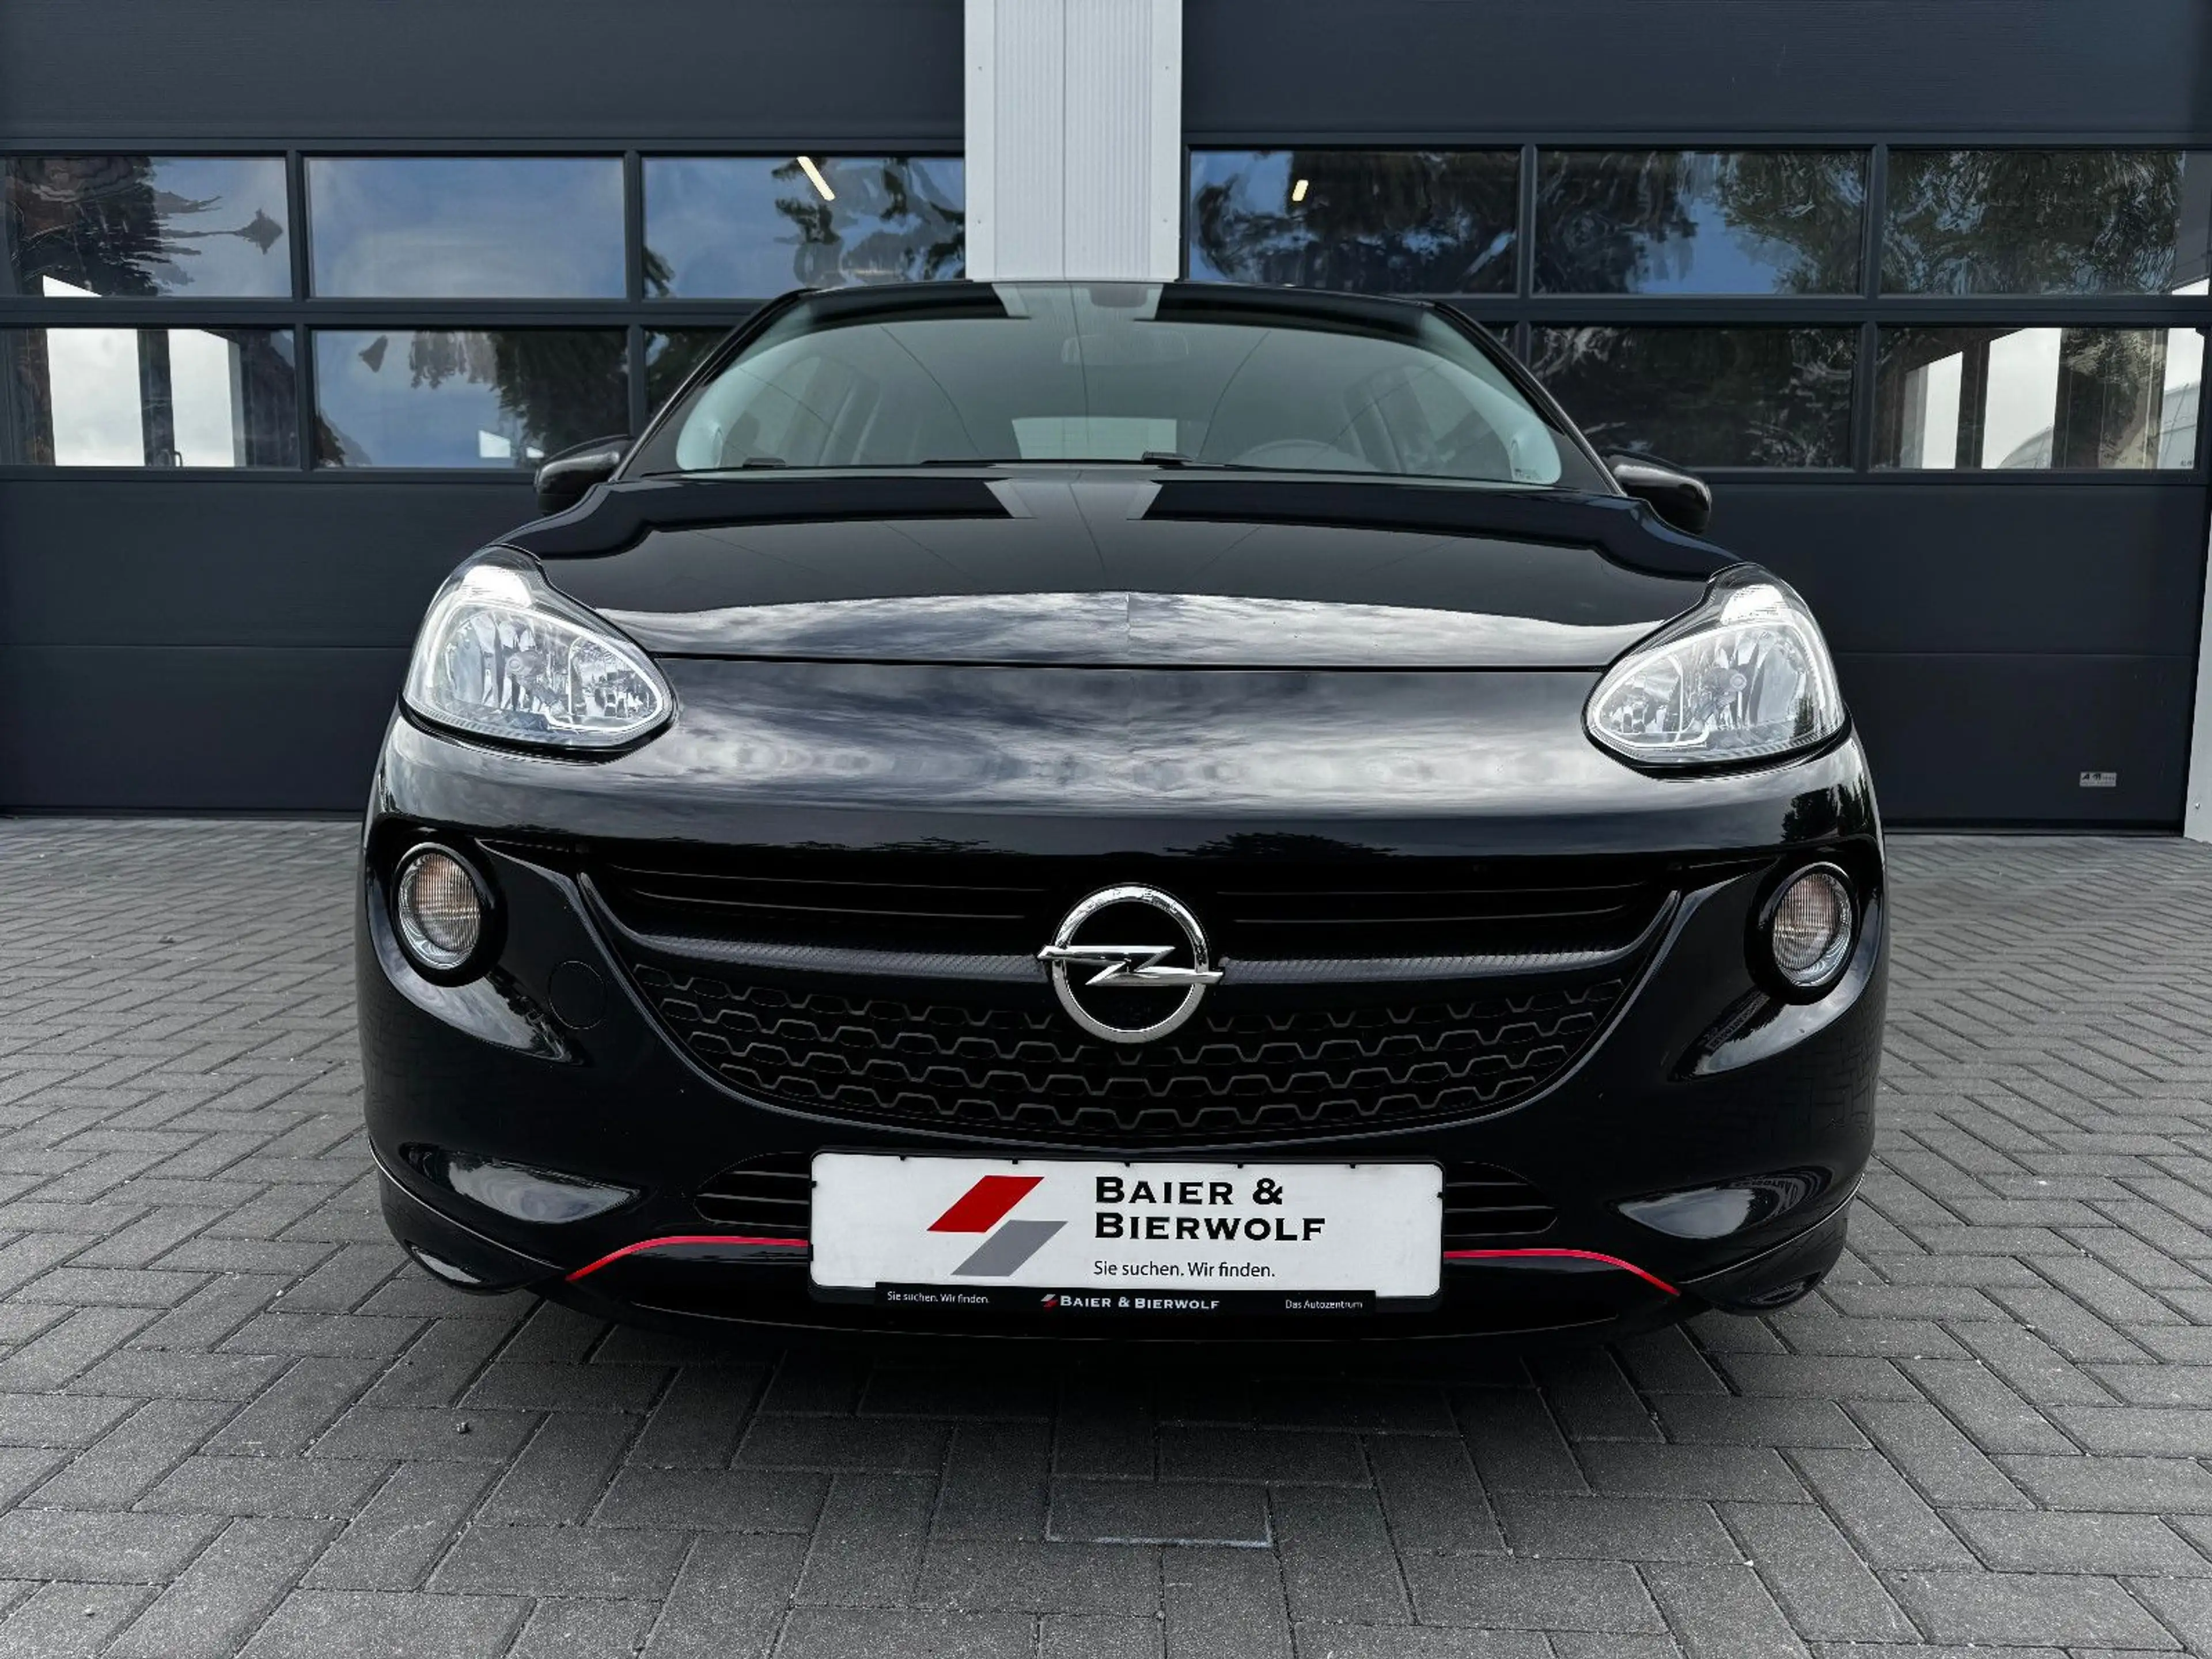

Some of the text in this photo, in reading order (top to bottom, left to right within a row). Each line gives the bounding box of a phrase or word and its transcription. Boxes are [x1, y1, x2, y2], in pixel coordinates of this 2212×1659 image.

[1096, 1177, 1282, 1205] BAIER &
[1095, 1213, 1325, 1241] BIERWOLF
[1094, 1261, 1275, 1277] Sie suchen. Wir finden.
[888, 1291, 901, 1301] Sie
[903, 1293, 938, 1302] suchen.
[940, 1294, 956, 1302] Wir
[1060, 1296, 1220, 1309] BAIER & BIERWOLF
[1285, 1300, 1363, 1309] Das Autozentrum
